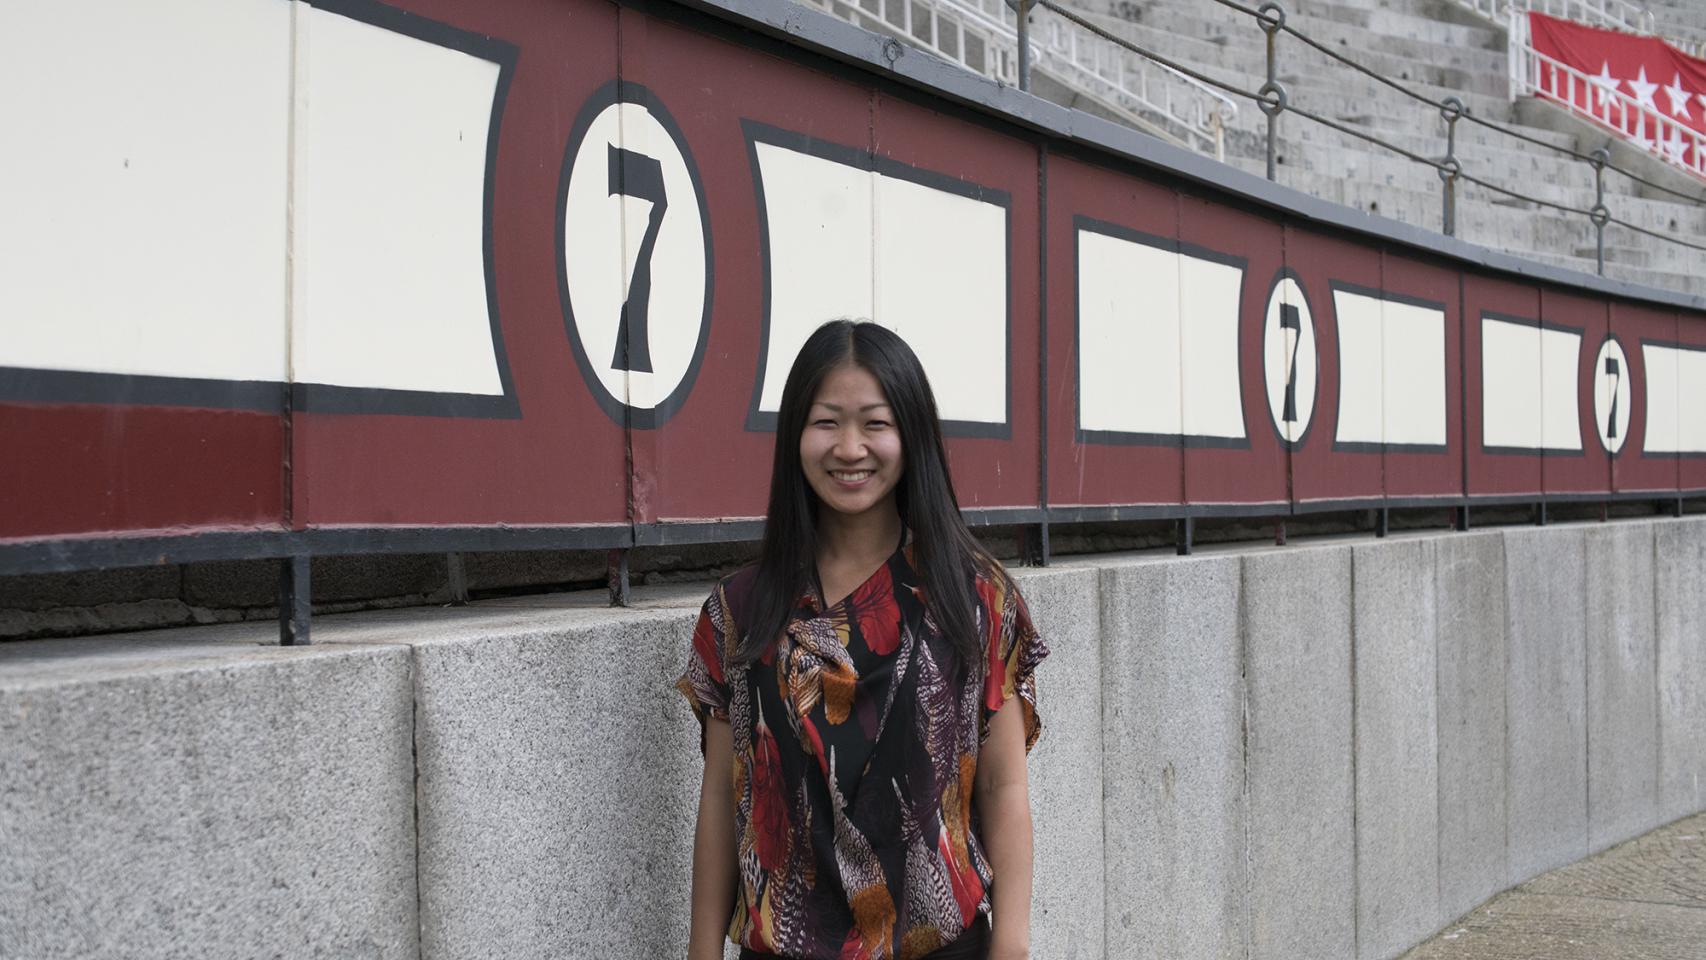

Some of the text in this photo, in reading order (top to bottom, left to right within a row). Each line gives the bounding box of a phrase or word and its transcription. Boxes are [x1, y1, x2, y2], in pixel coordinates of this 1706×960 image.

[607, 141, 668, 374] 7
[1279, 302, 1301, 422] 7
[1605, 357, 1620, 438] 7
